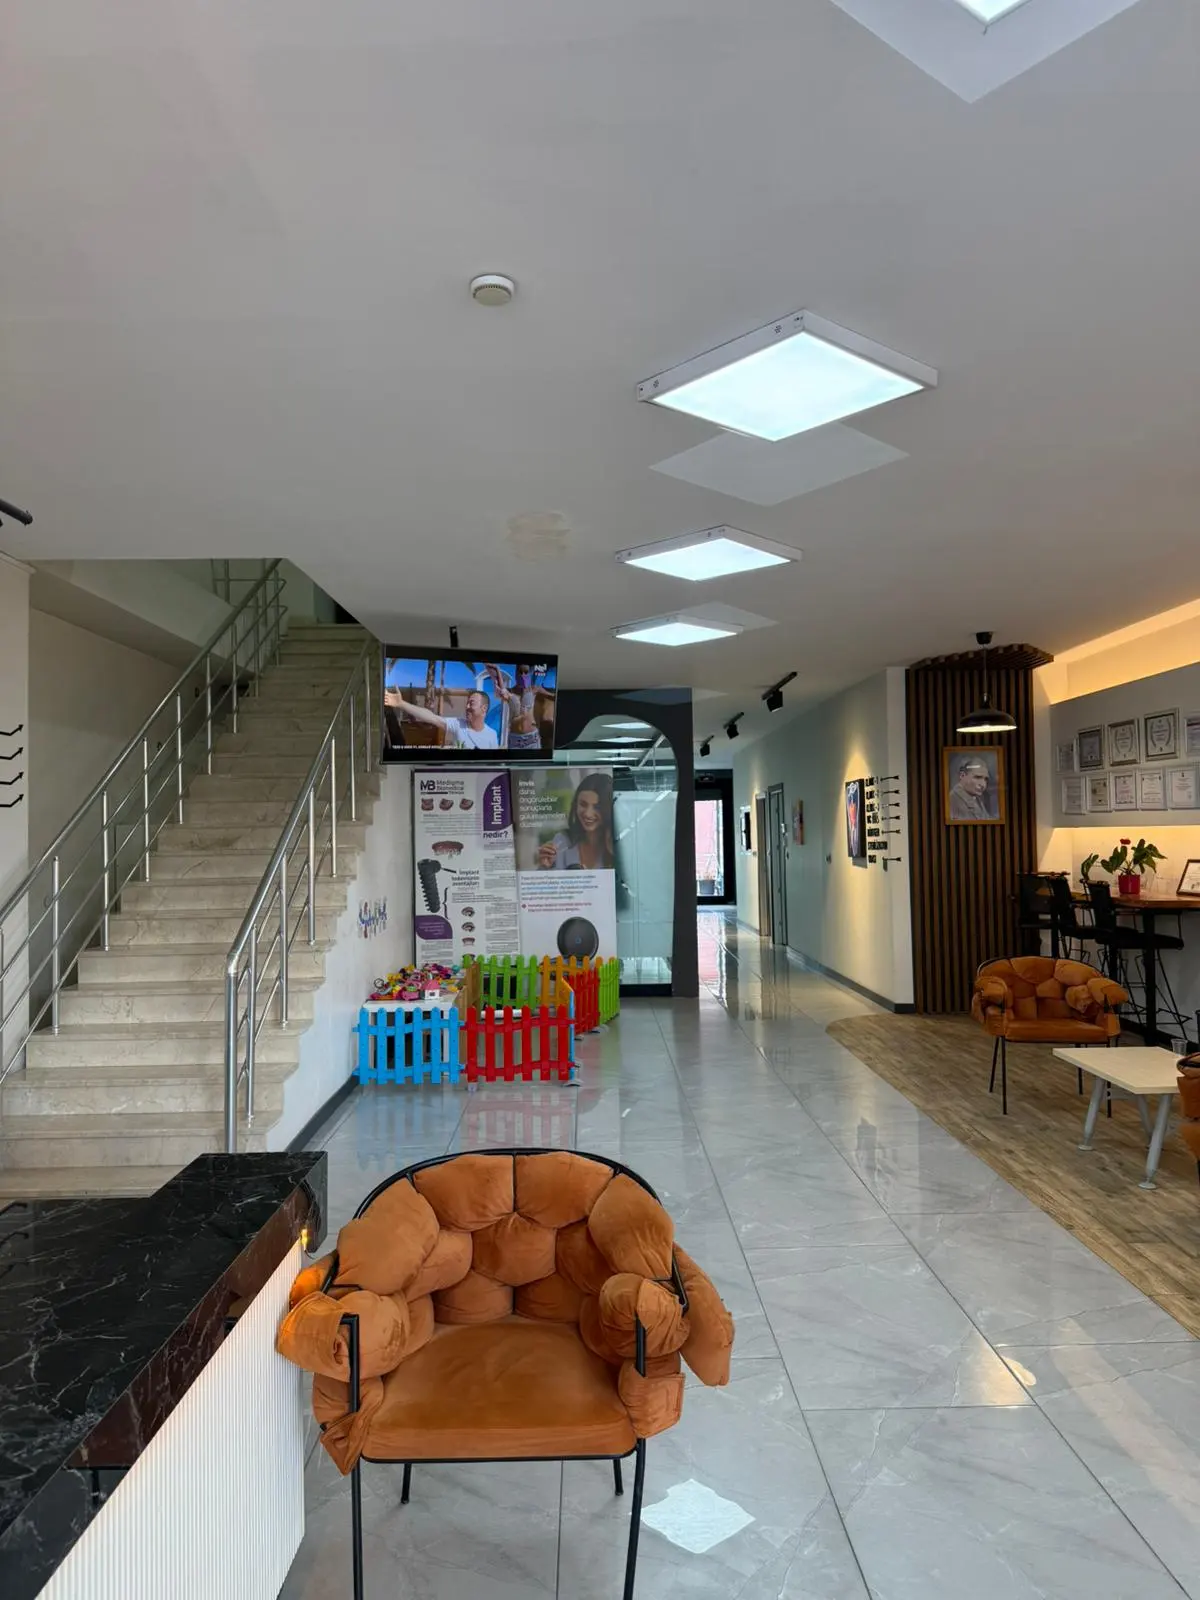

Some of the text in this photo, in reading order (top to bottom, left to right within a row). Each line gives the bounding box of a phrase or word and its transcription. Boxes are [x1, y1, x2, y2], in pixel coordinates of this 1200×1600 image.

[420, 780, 436, 791] MB
[491, 785, 504, 825] Implant
[483, 831, 508, 839] nedir?
